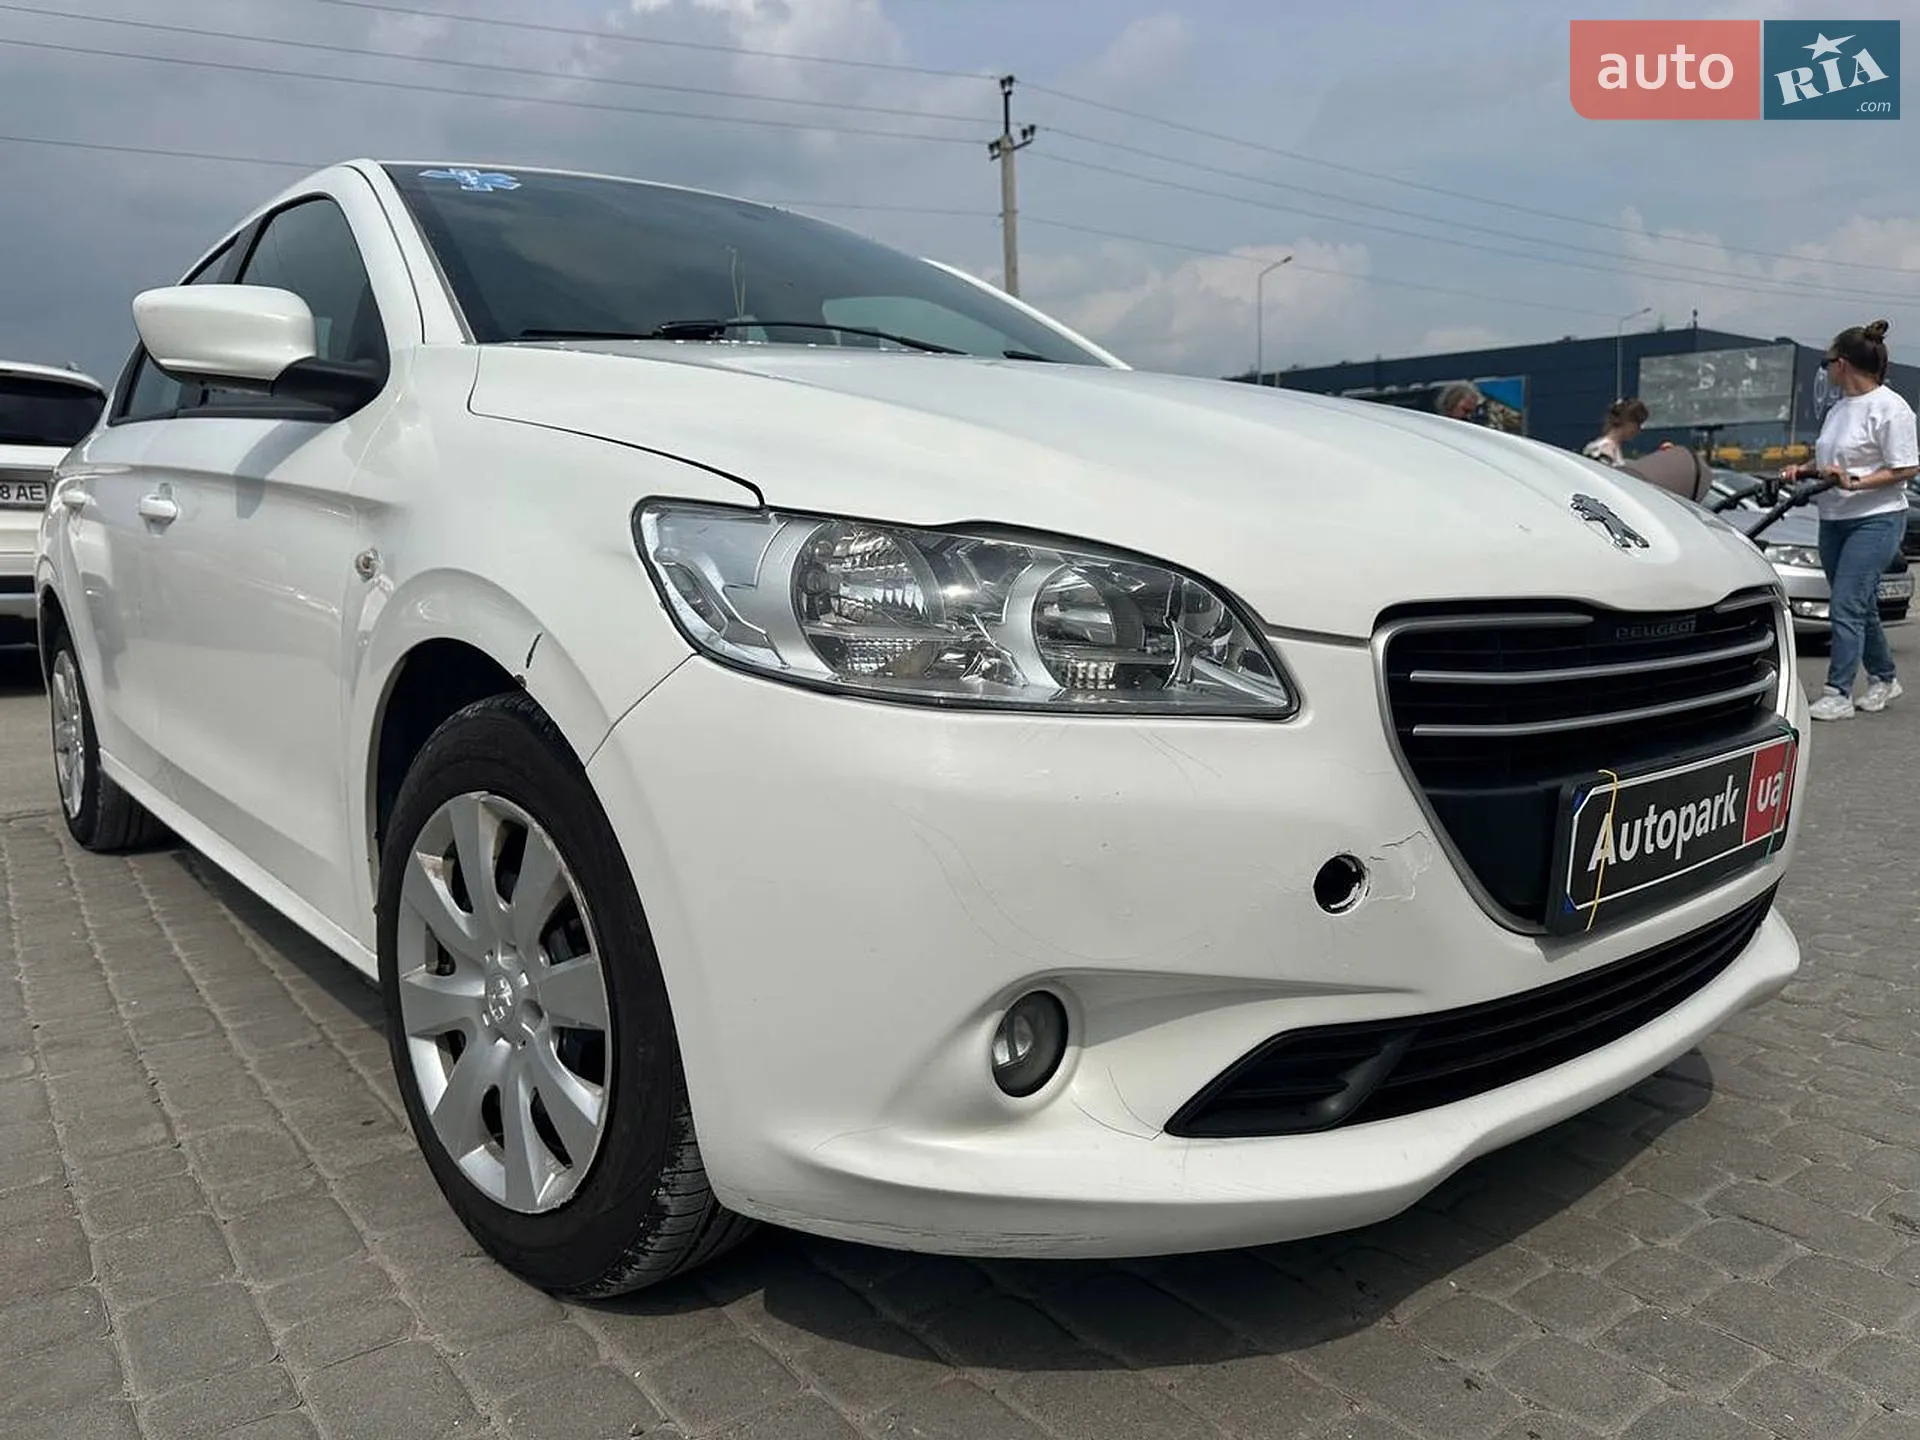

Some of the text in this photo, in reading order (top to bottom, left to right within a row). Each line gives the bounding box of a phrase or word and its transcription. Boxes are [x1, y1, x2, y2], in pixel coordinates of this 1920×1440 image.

[15, 485, 45, 501] AE
[1616, 619, 1697, 639] PEUGEOT
[1588, 771, 1786, 872] Autopark ua
